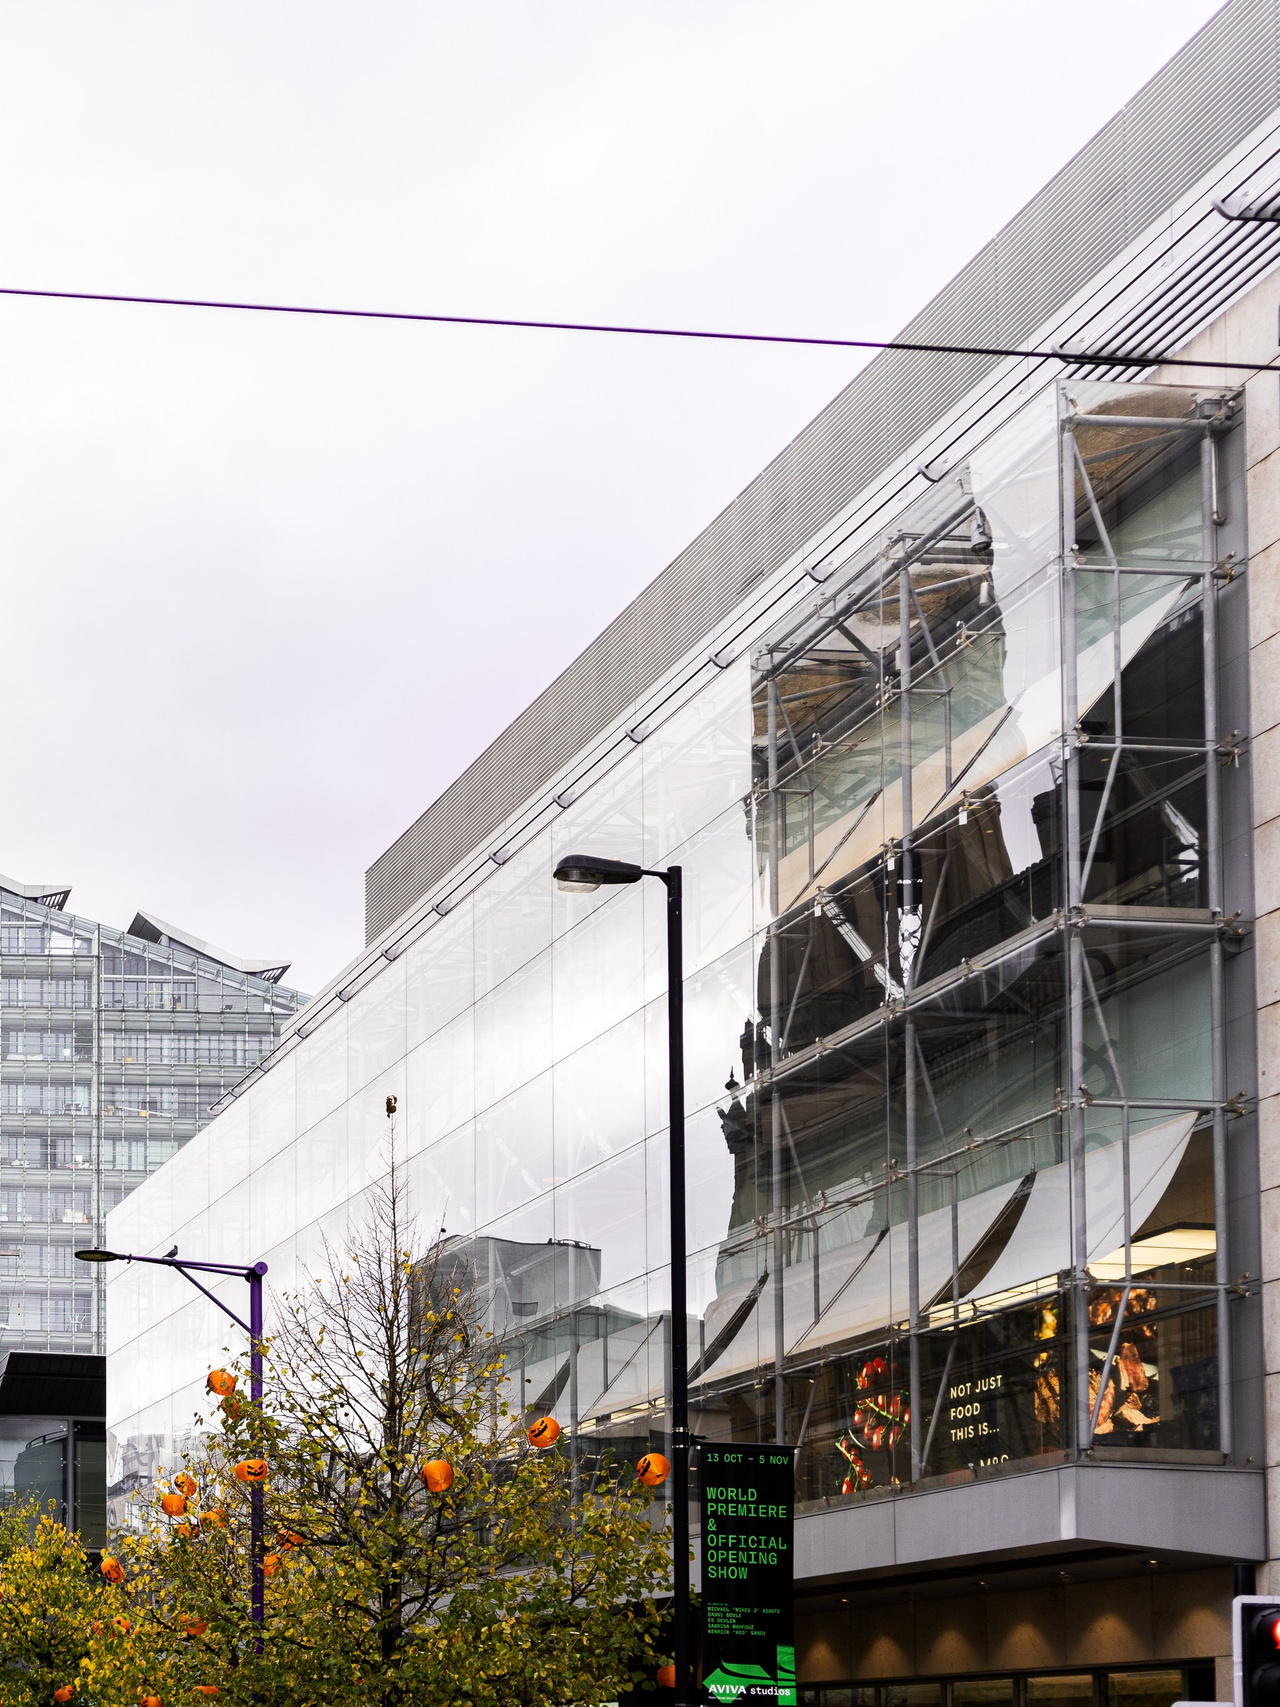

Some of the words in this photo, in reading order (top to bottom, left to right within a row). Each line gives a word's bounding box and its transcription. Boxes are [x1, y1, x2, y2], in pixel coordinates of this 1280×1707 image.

[950, 1382, 972, 1399] NOT
[975, 1374, 1003, 1393] JUST
[950, 1402, 981, 1420] FOOD
[950, 1425, 975, 1441] THIS
[978, 1422, 1000, 1436] IS...
[706, 1453, 720, 1462] 13
[723, 1453, 743, 1463] OCT
[759, 1455, 765, 1464] 5
[770, 1455, 789, 1465] NOV
[706, 1487, 757, 1501] WORLD
[707, 1503, 787, 1518] PREMIERE
[707, 1518, 717, 1531] &
[707, 1534, 787, 1550] OFFICIAL
[707, 1550, 778, 1565] OPENING
[708, 1565, 748, 1579] SHOW
[708, 1684, 747, 1694] AVIVA
[750, 1687, 791, 1696] studios
